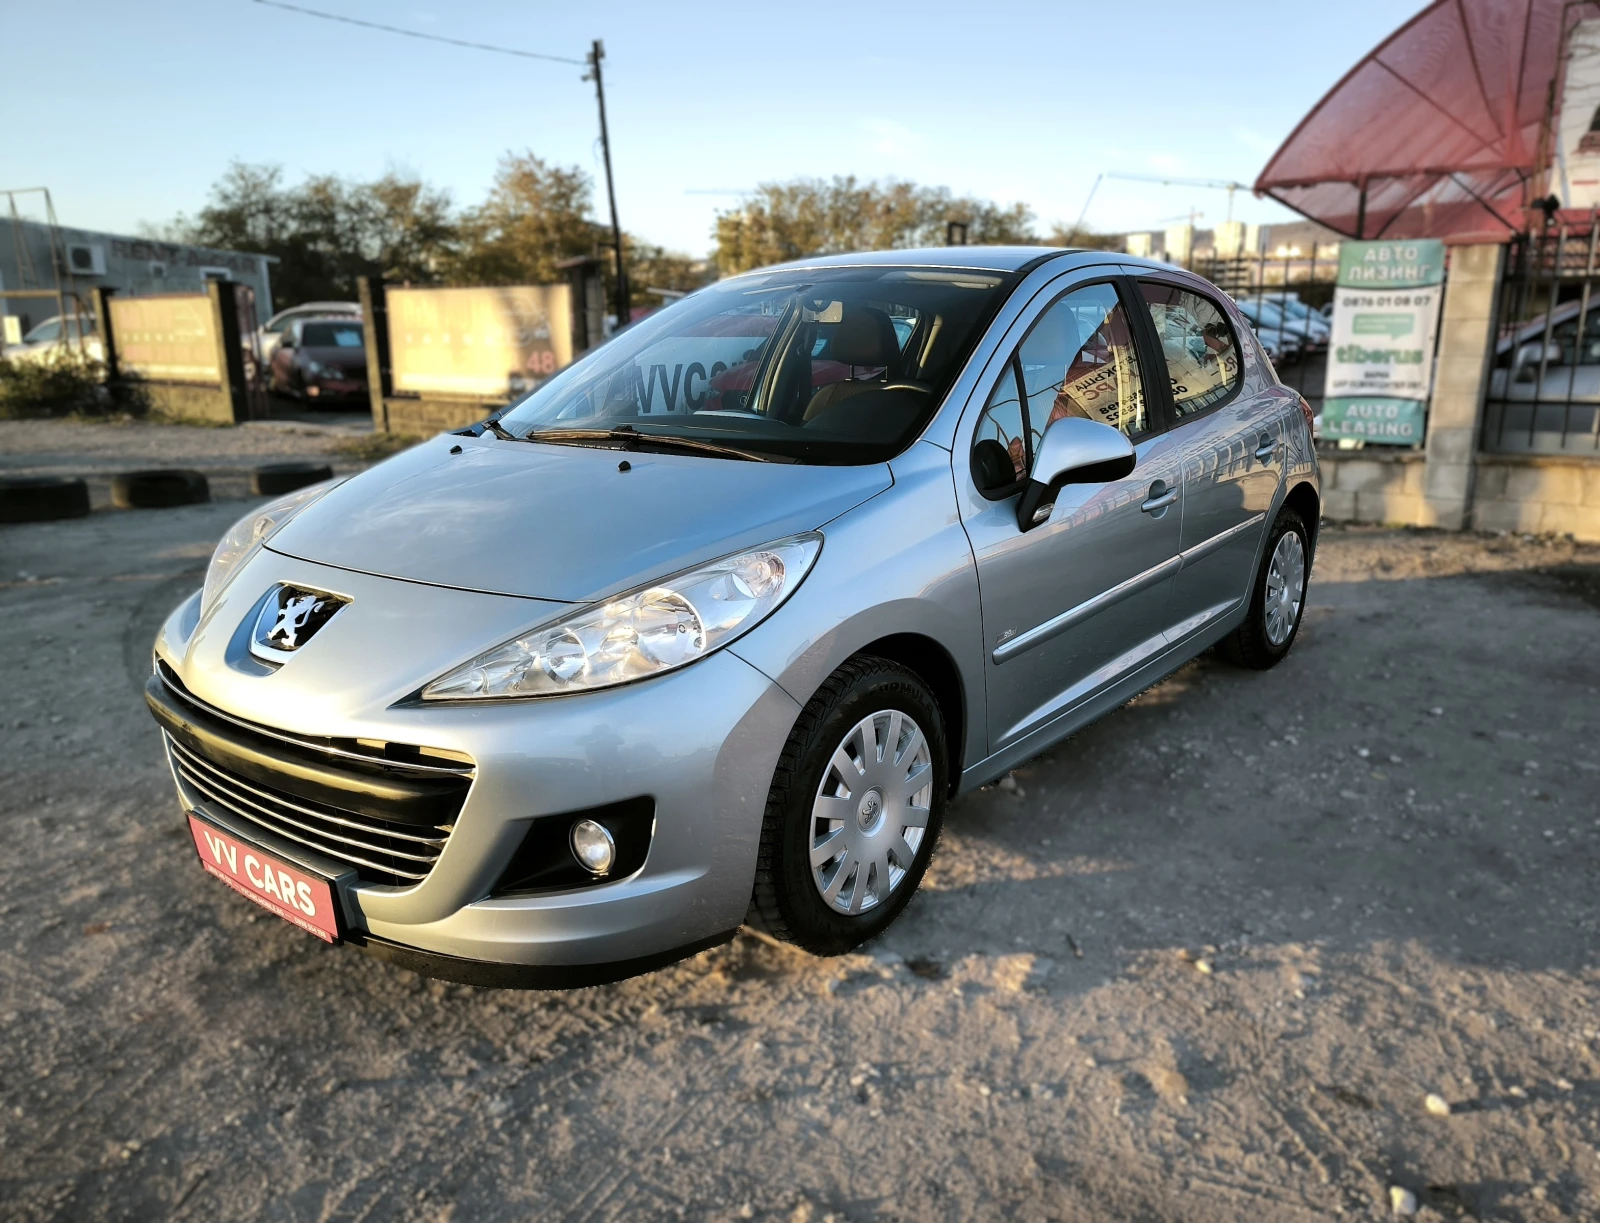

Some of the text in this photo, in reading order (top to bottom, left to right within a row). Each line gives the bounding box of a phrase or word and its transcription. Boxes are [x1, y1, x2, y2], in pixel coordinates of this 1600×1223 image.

[1364, 247, 1418, 262] АВТО
[1349, 264, 1431, 281] ЛИЗИНГ
[527, 351, 555, 374] 48
[1345, 404, 1398, 419] AUTO
[1329, 421, 1413, 437] LEASING
[204, 830, 238, 875] VV
[244, 854, 316, 917] CARS
